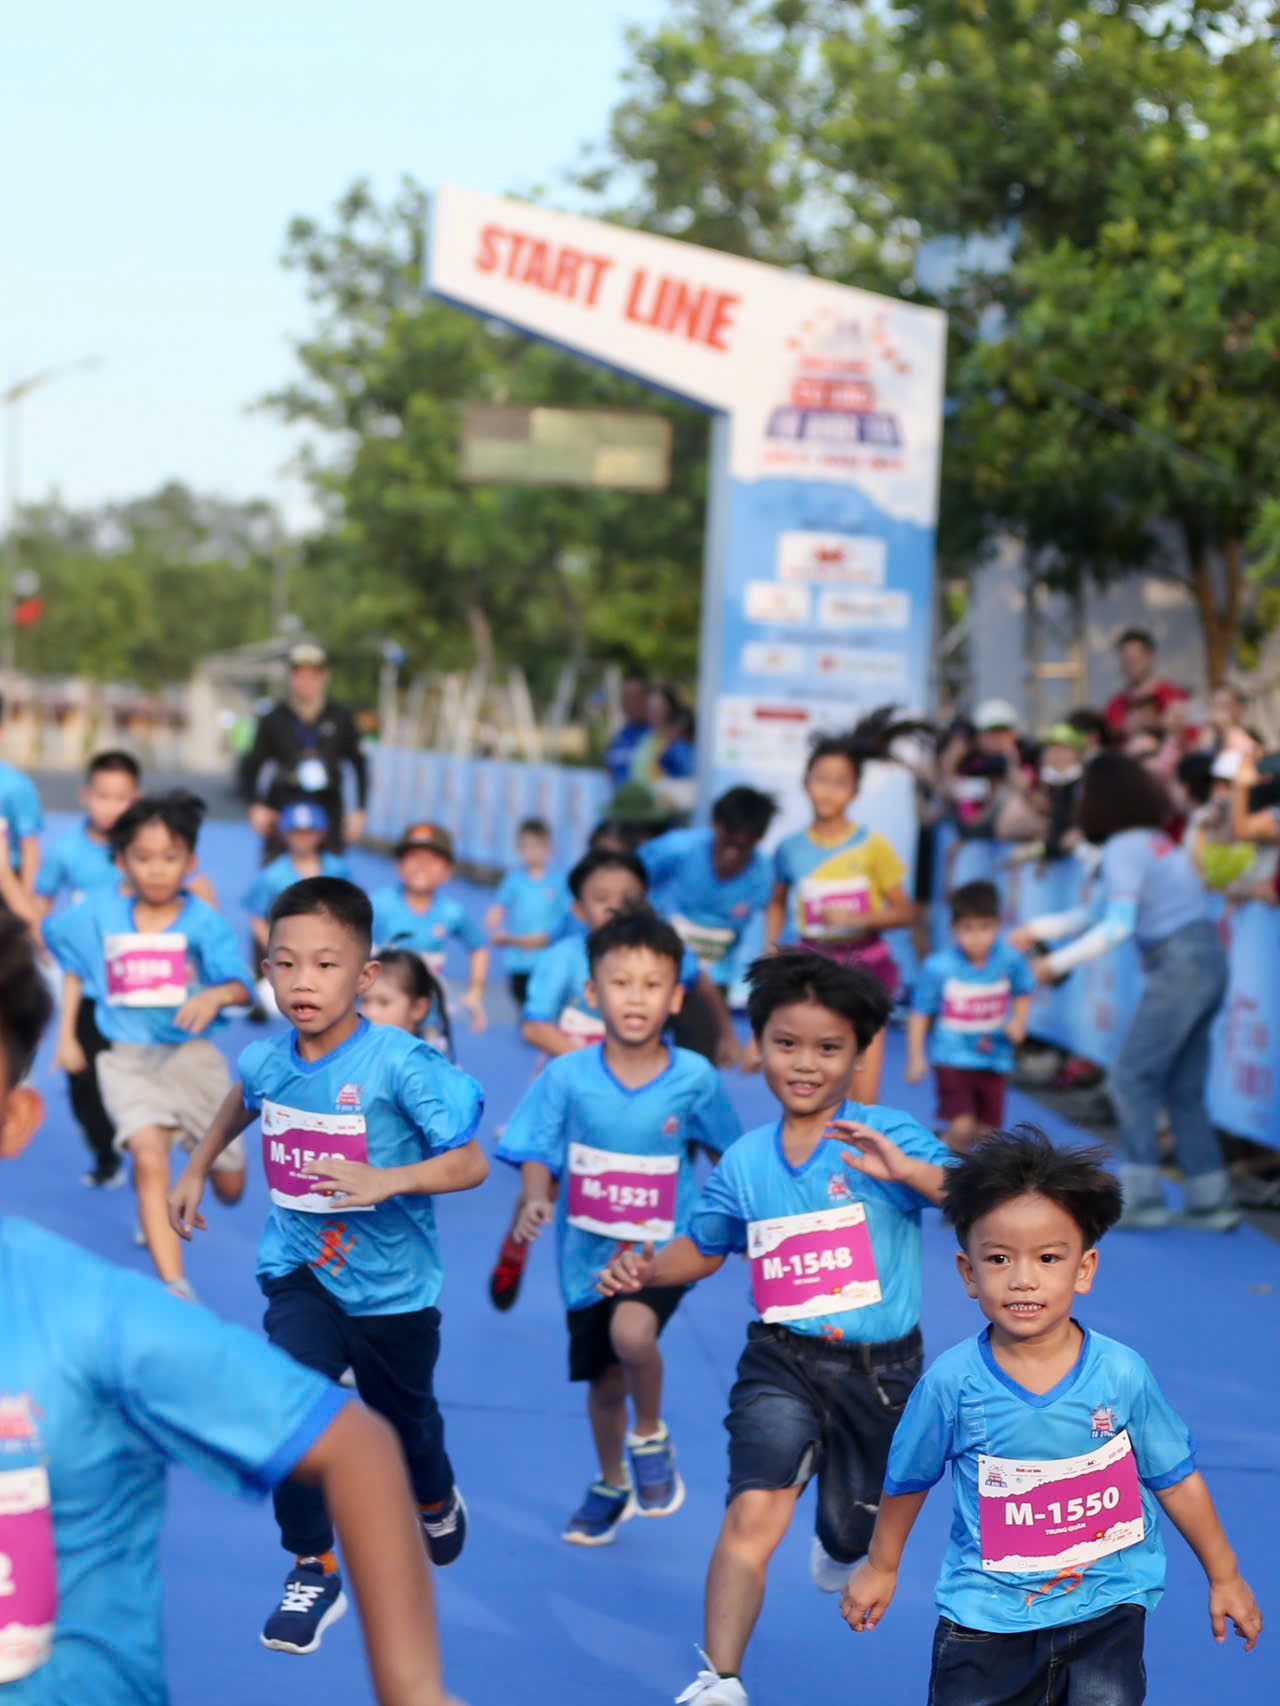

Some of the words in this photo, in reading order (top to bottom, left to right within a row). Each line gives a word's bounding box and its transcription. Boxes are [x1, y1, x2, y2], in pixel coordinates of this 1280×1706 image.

[476, 223, 613, 308] START
[624, 268, 742, 352] LINE
[582, 1177, 659, 1208] M-1521
[763, 1246, 854, 1280] M-1548
[1005, 1486, 1120, 1526] M-1550
[1045, 1526, 1068, 1536] TRUNG
